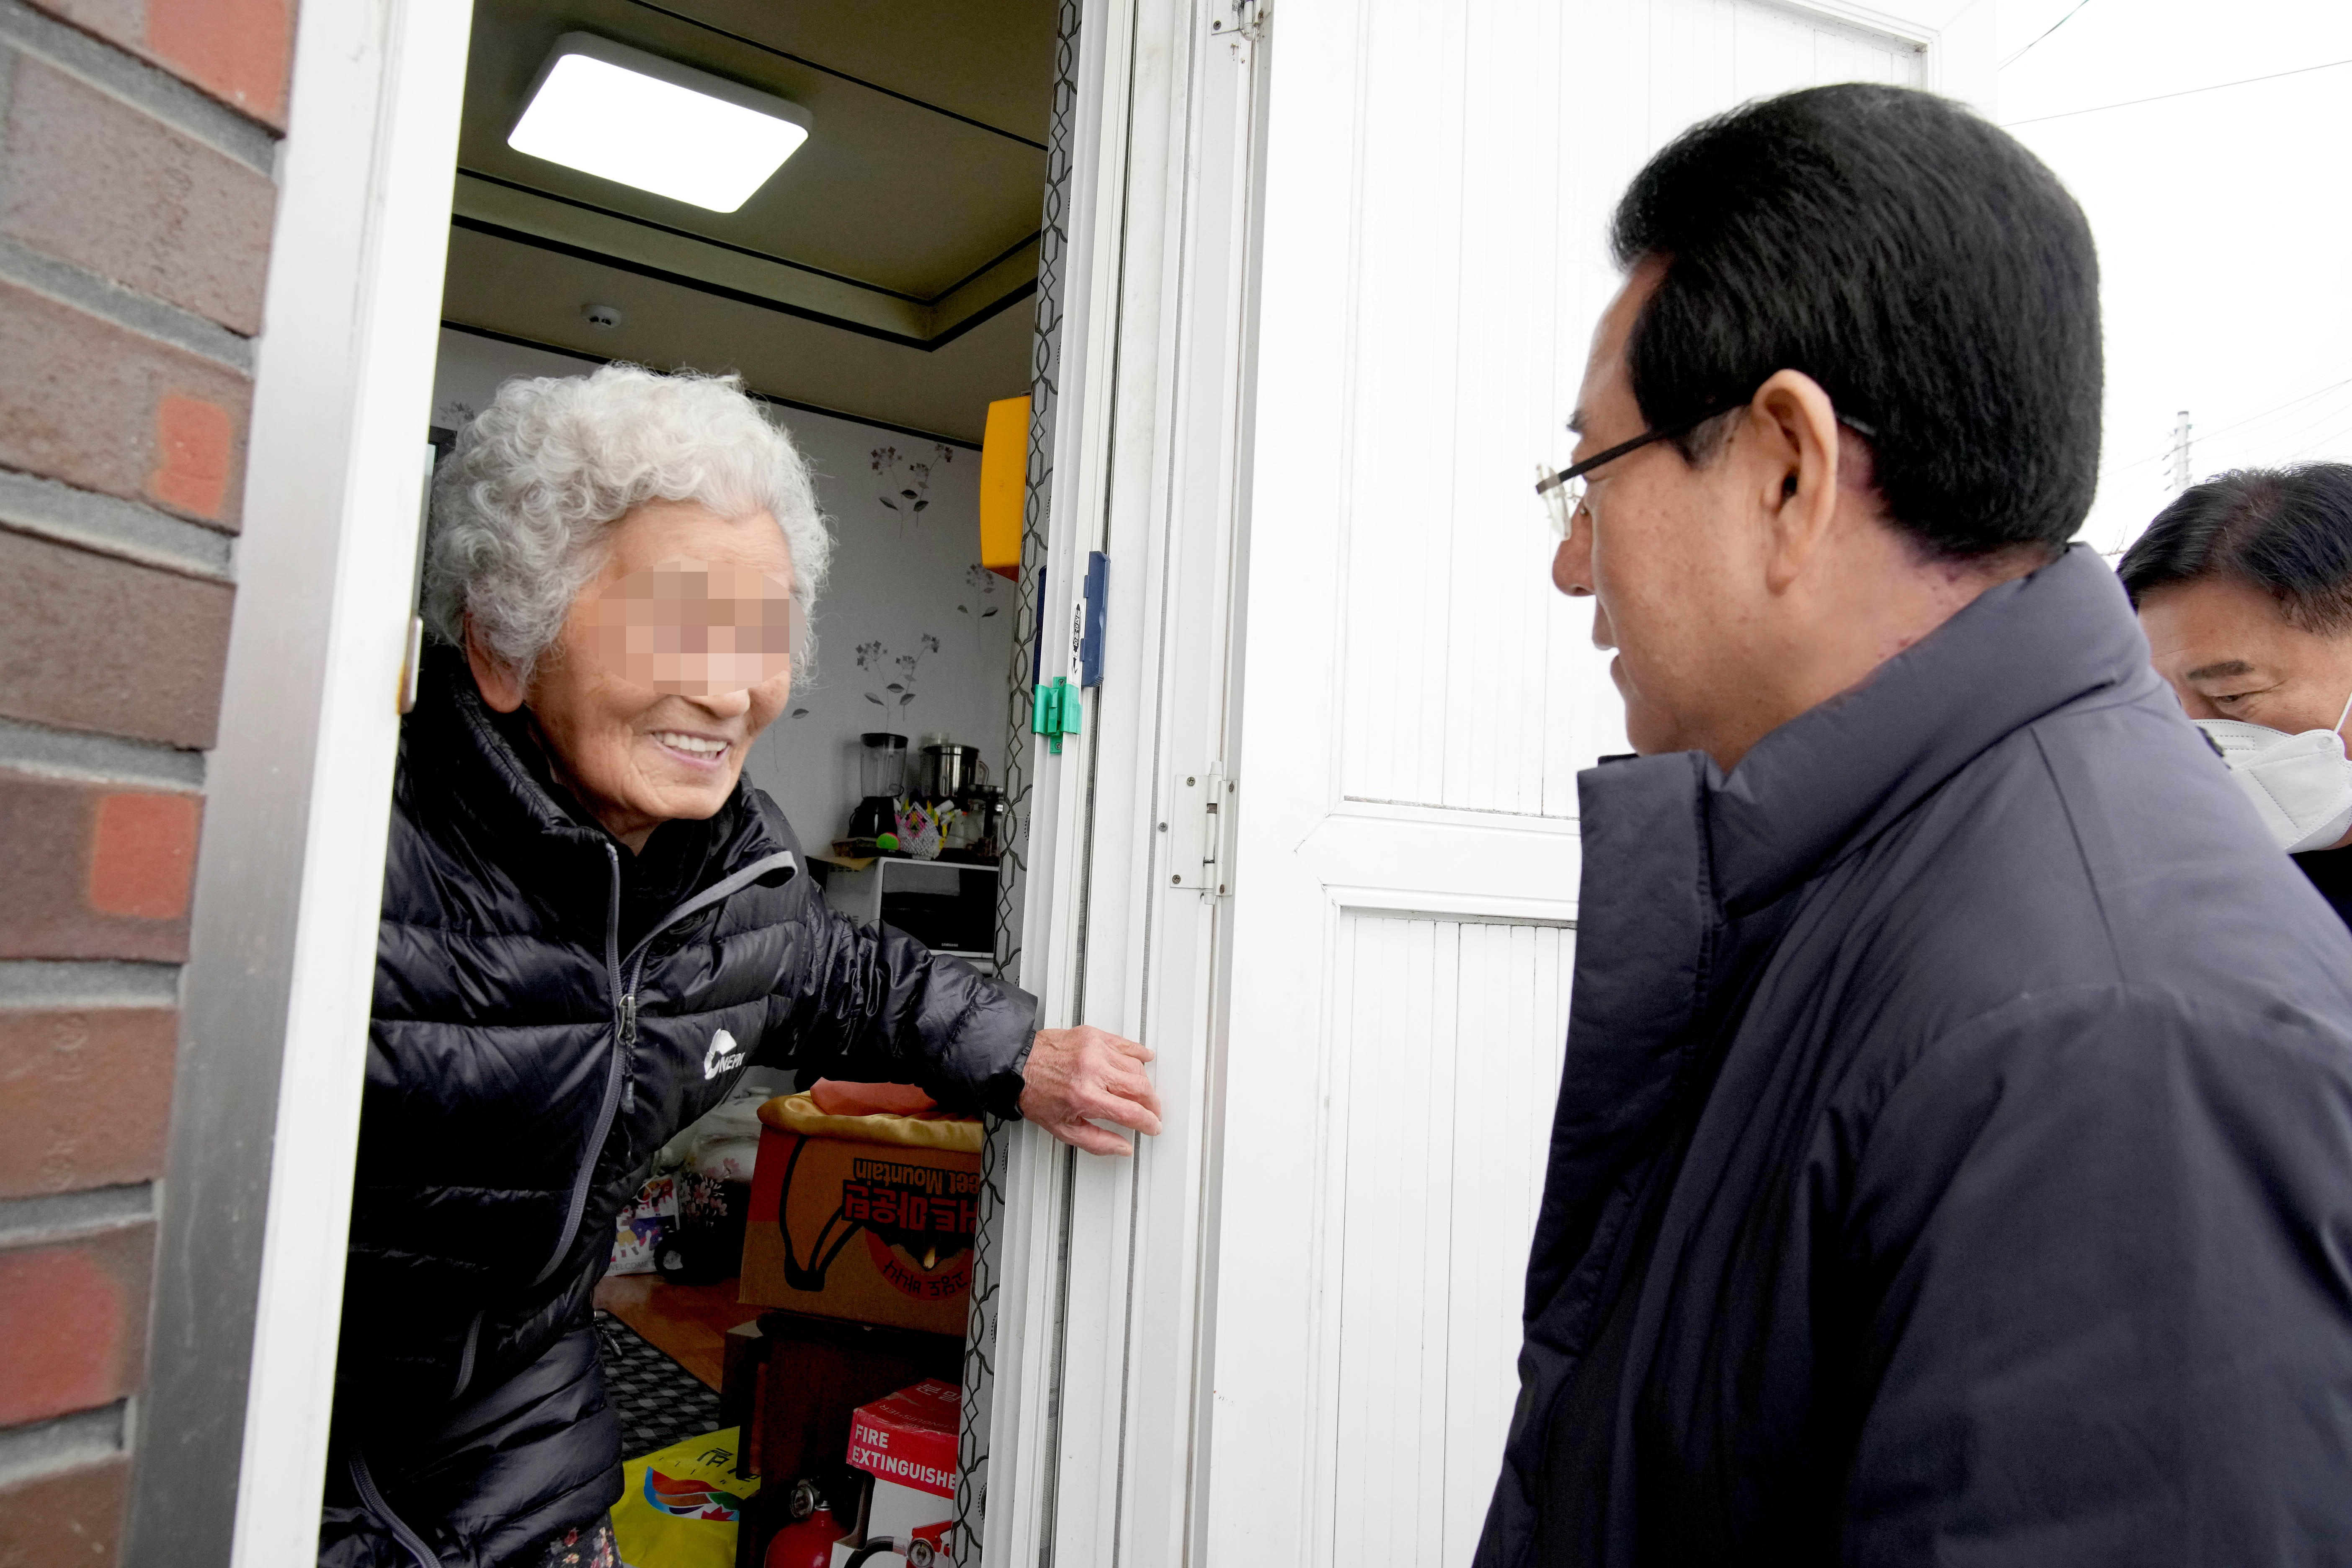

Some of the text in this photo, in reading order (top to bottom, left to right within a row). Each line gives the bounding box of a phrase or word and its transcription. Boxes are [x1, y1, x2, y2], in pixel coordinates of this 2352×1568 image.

[855, 1160, 943, 1196] Mountain
[883, 1260, 968, 1296] 고당도 바나나
[855, 1424, 890, 1449] FIRE
